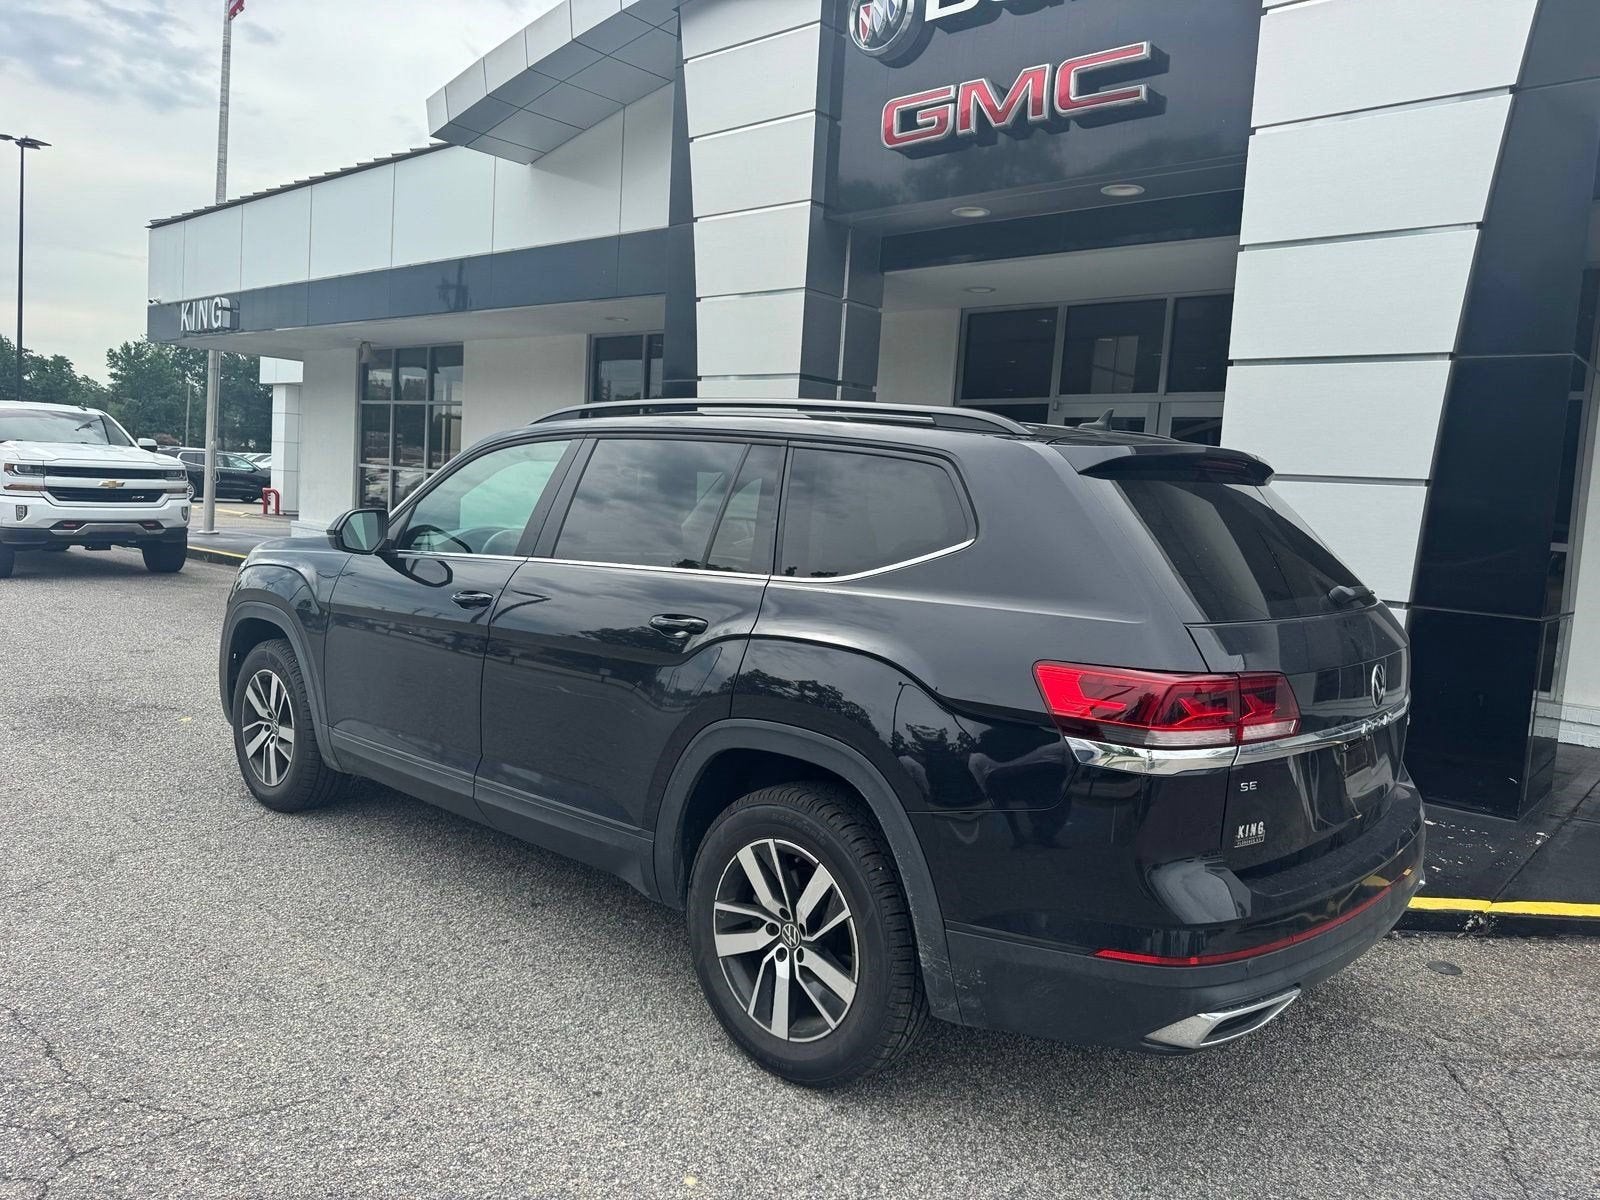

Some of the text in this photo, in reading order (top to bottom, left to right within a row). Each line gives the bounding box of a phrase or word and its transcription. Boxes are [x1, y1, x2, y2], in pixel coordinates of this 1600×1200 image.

[881, 41, 1151, 149] GMC
[180, 296, 222, 331] KING
[1240, 780, 1258, 792] SE
[1237, 821, 1265, 839] KING
